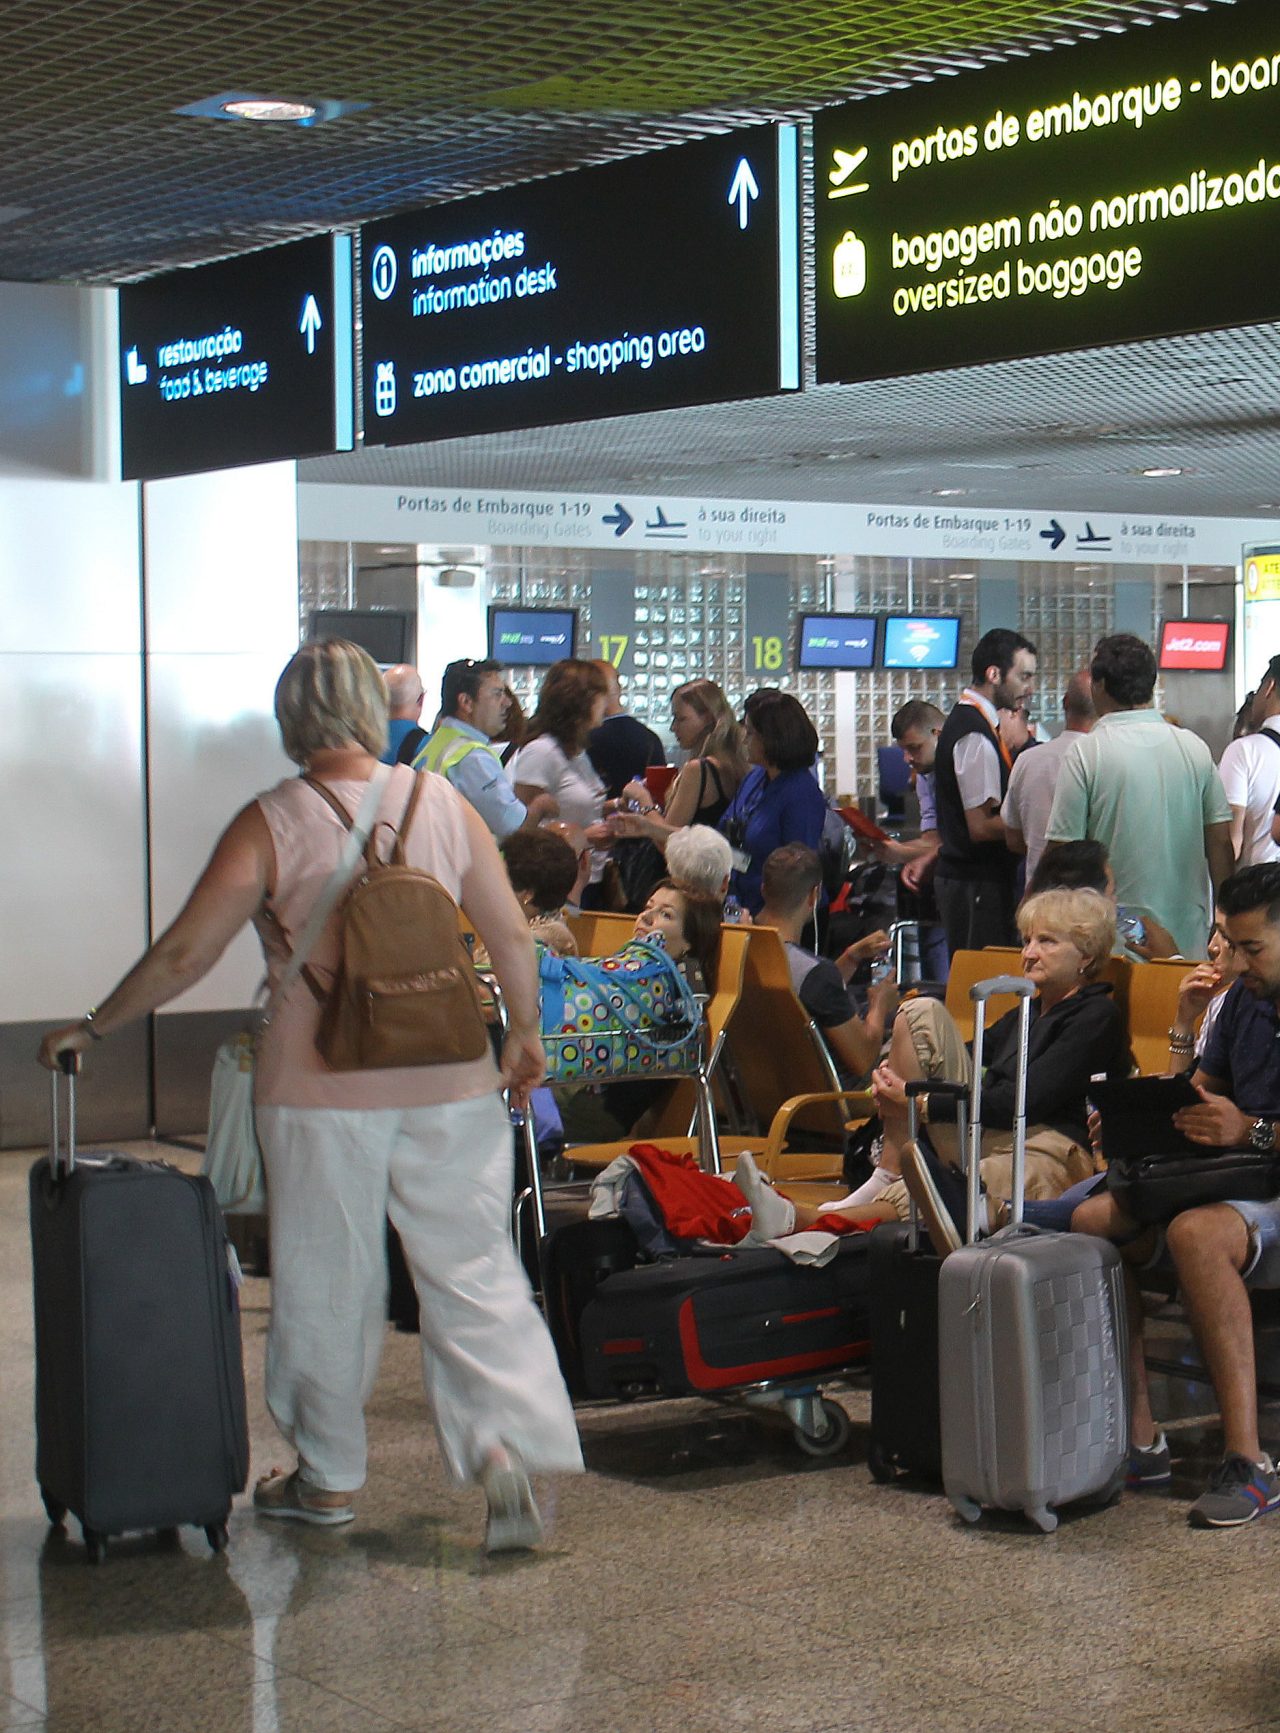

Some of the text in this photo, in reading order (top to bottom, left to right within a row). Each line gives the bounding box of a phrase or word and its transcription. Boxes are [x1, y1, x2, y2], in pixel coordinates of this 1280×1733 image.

[891, 122, 978, 180] portas
[984, 109, 1019, 149] de
[1027, 77, 1182, 142] embarque
[891, 214, 1022, 271] bagagem
[1027, 201, 1082, 244] não
[411, 229, 525, 278] informações
[412, 261, 557, 317] information desk
[892, 244, 1143, 316] oversized baggage
[205, 361, 268, 392] beverage
[413, 369, 456, 398] zona
[460, 345, 550, 391] comercial
[566, 331, 653, 375] shopping
[658, 326, 705, 359] area
[397, 495, 592, 518] Portas de Embarque 1-19
[710, 509, 736, 522] sua
[740, 507, 786, 524] direita
[867, 512, 1032, 534] Portas de Embarque 1-19
[487, 519, 592, 540] Boarding Gates
[1131, 524, 1153, 536] sua
[1157, 522, 1196, 538] direita
[599, 636, 629, 669] 17
[752, 636, 784, 669] 18
[1165, 637, 1222, 652] Jet2.com
